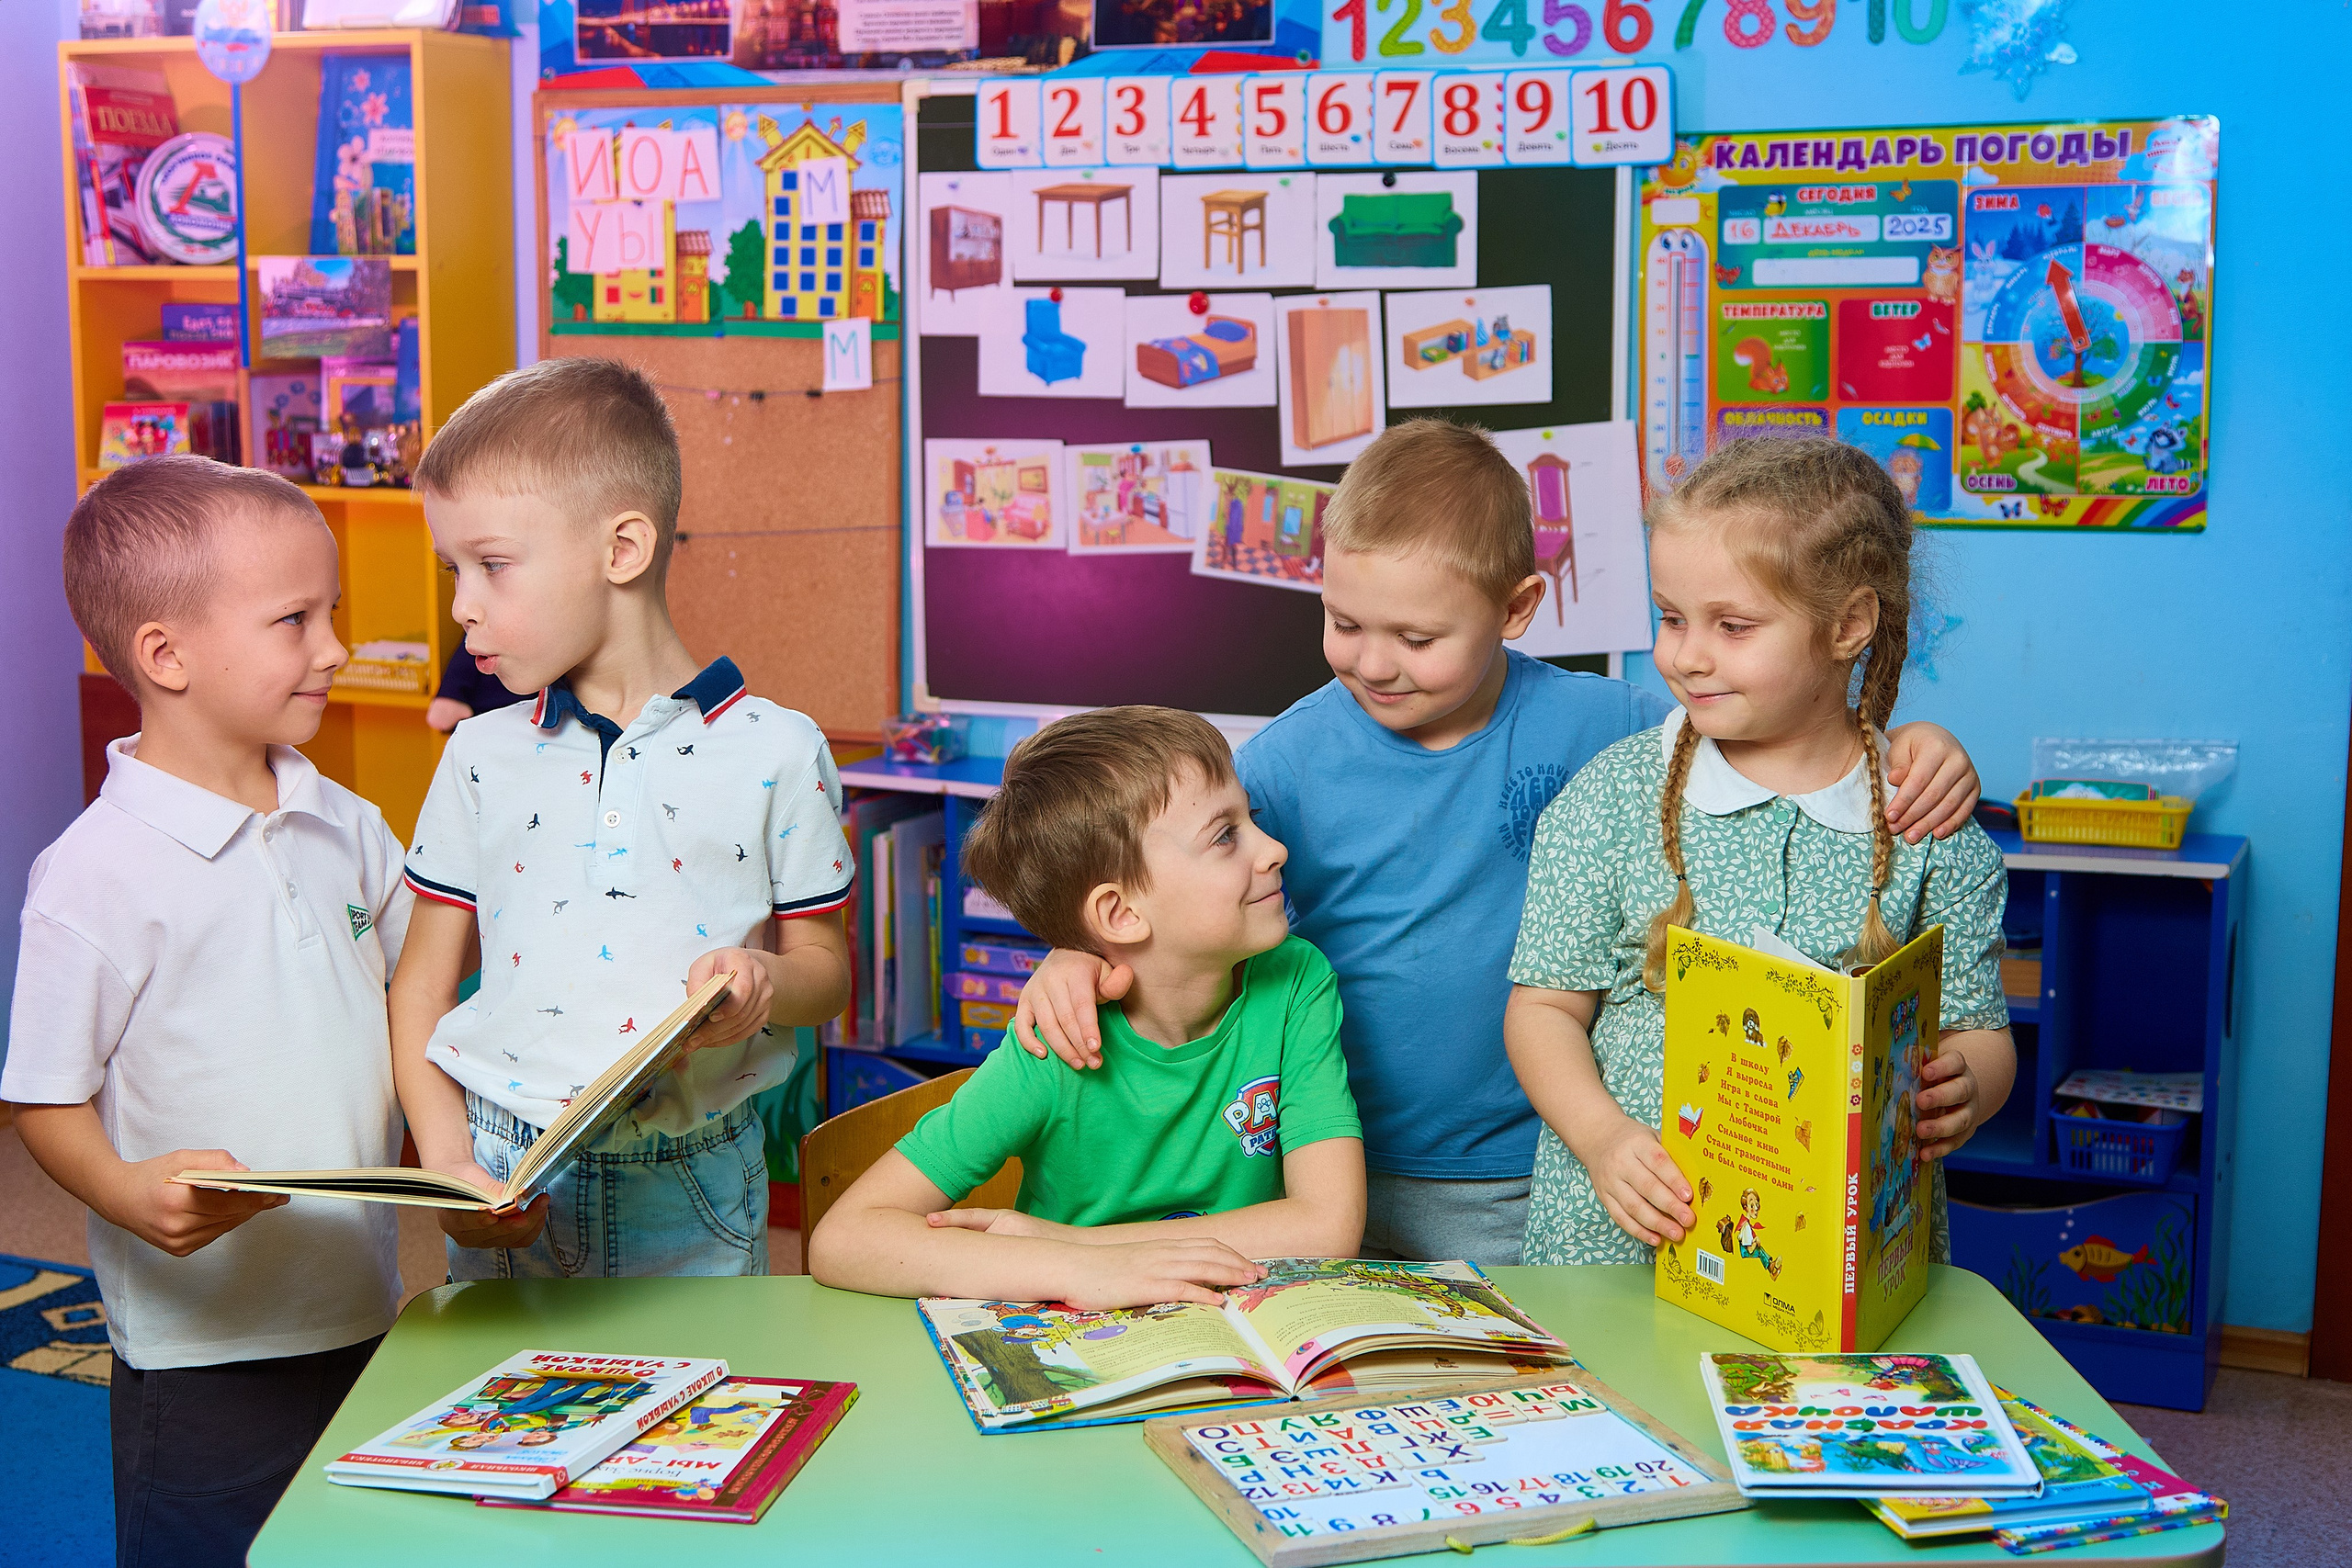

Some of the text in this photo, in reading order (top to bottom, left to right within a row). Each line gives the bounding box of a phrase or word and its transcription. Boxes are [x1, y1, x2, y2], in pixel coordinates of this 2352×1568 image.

[1333, 0, 1366, 62] 1
[1378, 0, 1424, 56] 2
[1430, 0, 1477, 54] 3
[1482, 0, 1535, 56] 4
[1544, 0, 1591, 56] 5
[1604, 0, 1654, 53] 6
[990, 76, 1658, 140] 1 2 3 4 5 6 7 8 9 10
[1714, 133, 1945, 175] КАЛЕНДАРЬ
[1952, 128, 2132, 168] ПОГОДЫ
[806, 167, 839, 217] М
[1797, 186, 1877, 204] СЕГОДНЯ
[1973, 192, 2020, 212] ЗИМА
[1730, 220, 1755, 239] 16
[1770, 220, 1862, 240] ДЕКАБРЬ
[1888, 216, 1948, 237] 2025
[1723, 303, 1827, 320] ТЕМПЕРАТУРА
[1871, 301, 1922, 320] ВЕТЕР
[831, 329, 861, 381] М
[1861, 412, 1928, 426] ОСАДКИ
[1966, 474, 2018, 491] ОСЕНЬ
[2145, 476, 2191, 492] ЛЕТО
[1516, 766, 1533, 781] TO
[1731, 1052, 1770, 1076] В школу
[1726, 1066, 1774, 1091] Я выросла
[1720, 1078, 1742, 1095] Игра
[1754, 1094, 1779, 1109] слова
[1222, 1088, 1280, 1137] PA
[1717, 1093, 1732, 1107] Мы
[1743, 1102, 1781, 1125] Тамарой
[1728, 1112, 1769, 1135] Любочка
[1717, 1123, 1780, 1155] Сильное кино
[1706, 1134, 1792, 1175] Стали грамотными
[1702, 1147, 1794, 1191] Он был совсем один
[1844, 1172, 1859, 1294] ПЕРВЫЙ УРОК
[1883, 1261, 1906, 1303] УРОК
[1772, 1296, 1795, 1314] ОЛМА
[529, 1354, 692, 1370] С УЛЫБКОЙ
[537, 1363, 657, 1378] О ШКОЛЕ
[636, 1366, 723, 1431] О ШКОЛЕ С УЛЫБКОЙ
[1559, 1398, 1599, 1412] М
[1198, 1384, 1578, 1439] Ы Ч Ю Ё Щ Ф Я У П О
[1724, 1405, 1984, 1417] ШАПОЧКА
[1325, 1427, 1353, 1440] А
[1367, 1422, 1400, 1436] В
[1409, 1419, 1447, 1431] Ц
[1732, 1417, 1989, 1433] КРАСНАЯ
[1215, 1440, 1245, 1453] С
[1221, 1426, 1495, 1468] Е Ж Г Л Ш Э Б
[1256, 1437, 1282, 1450] Т
[1288, 1431, 1318, 1445] Й
[1436, 1444, 1473, 1459] Х
[349, 1455, 538, 1472] ШКОЛЬНАЯ БИБЛИОТЕКА
[605, 1456, 723, 1471] МЫ ДР
[1355, 1455, 1386, 1469] Д
[631, 1467, 683, 1478] Борис
[1240, 1470, 1267, 1483] Р
[1280, 1464, 1316, 1479] Н
[1368, 1471, 1398, 1484] К
[1240, 1486, 1280, 1500] 12
[1262, 1460, 1674, 1521] 20 19 18 17 16 15 10
[1282, 1482, 1320, 1495] 13
[1323, 1477, 1362, 1491] 14
[1279, 1474, 1690, 1538] 1 2 3 4 5 6 8 9 11
